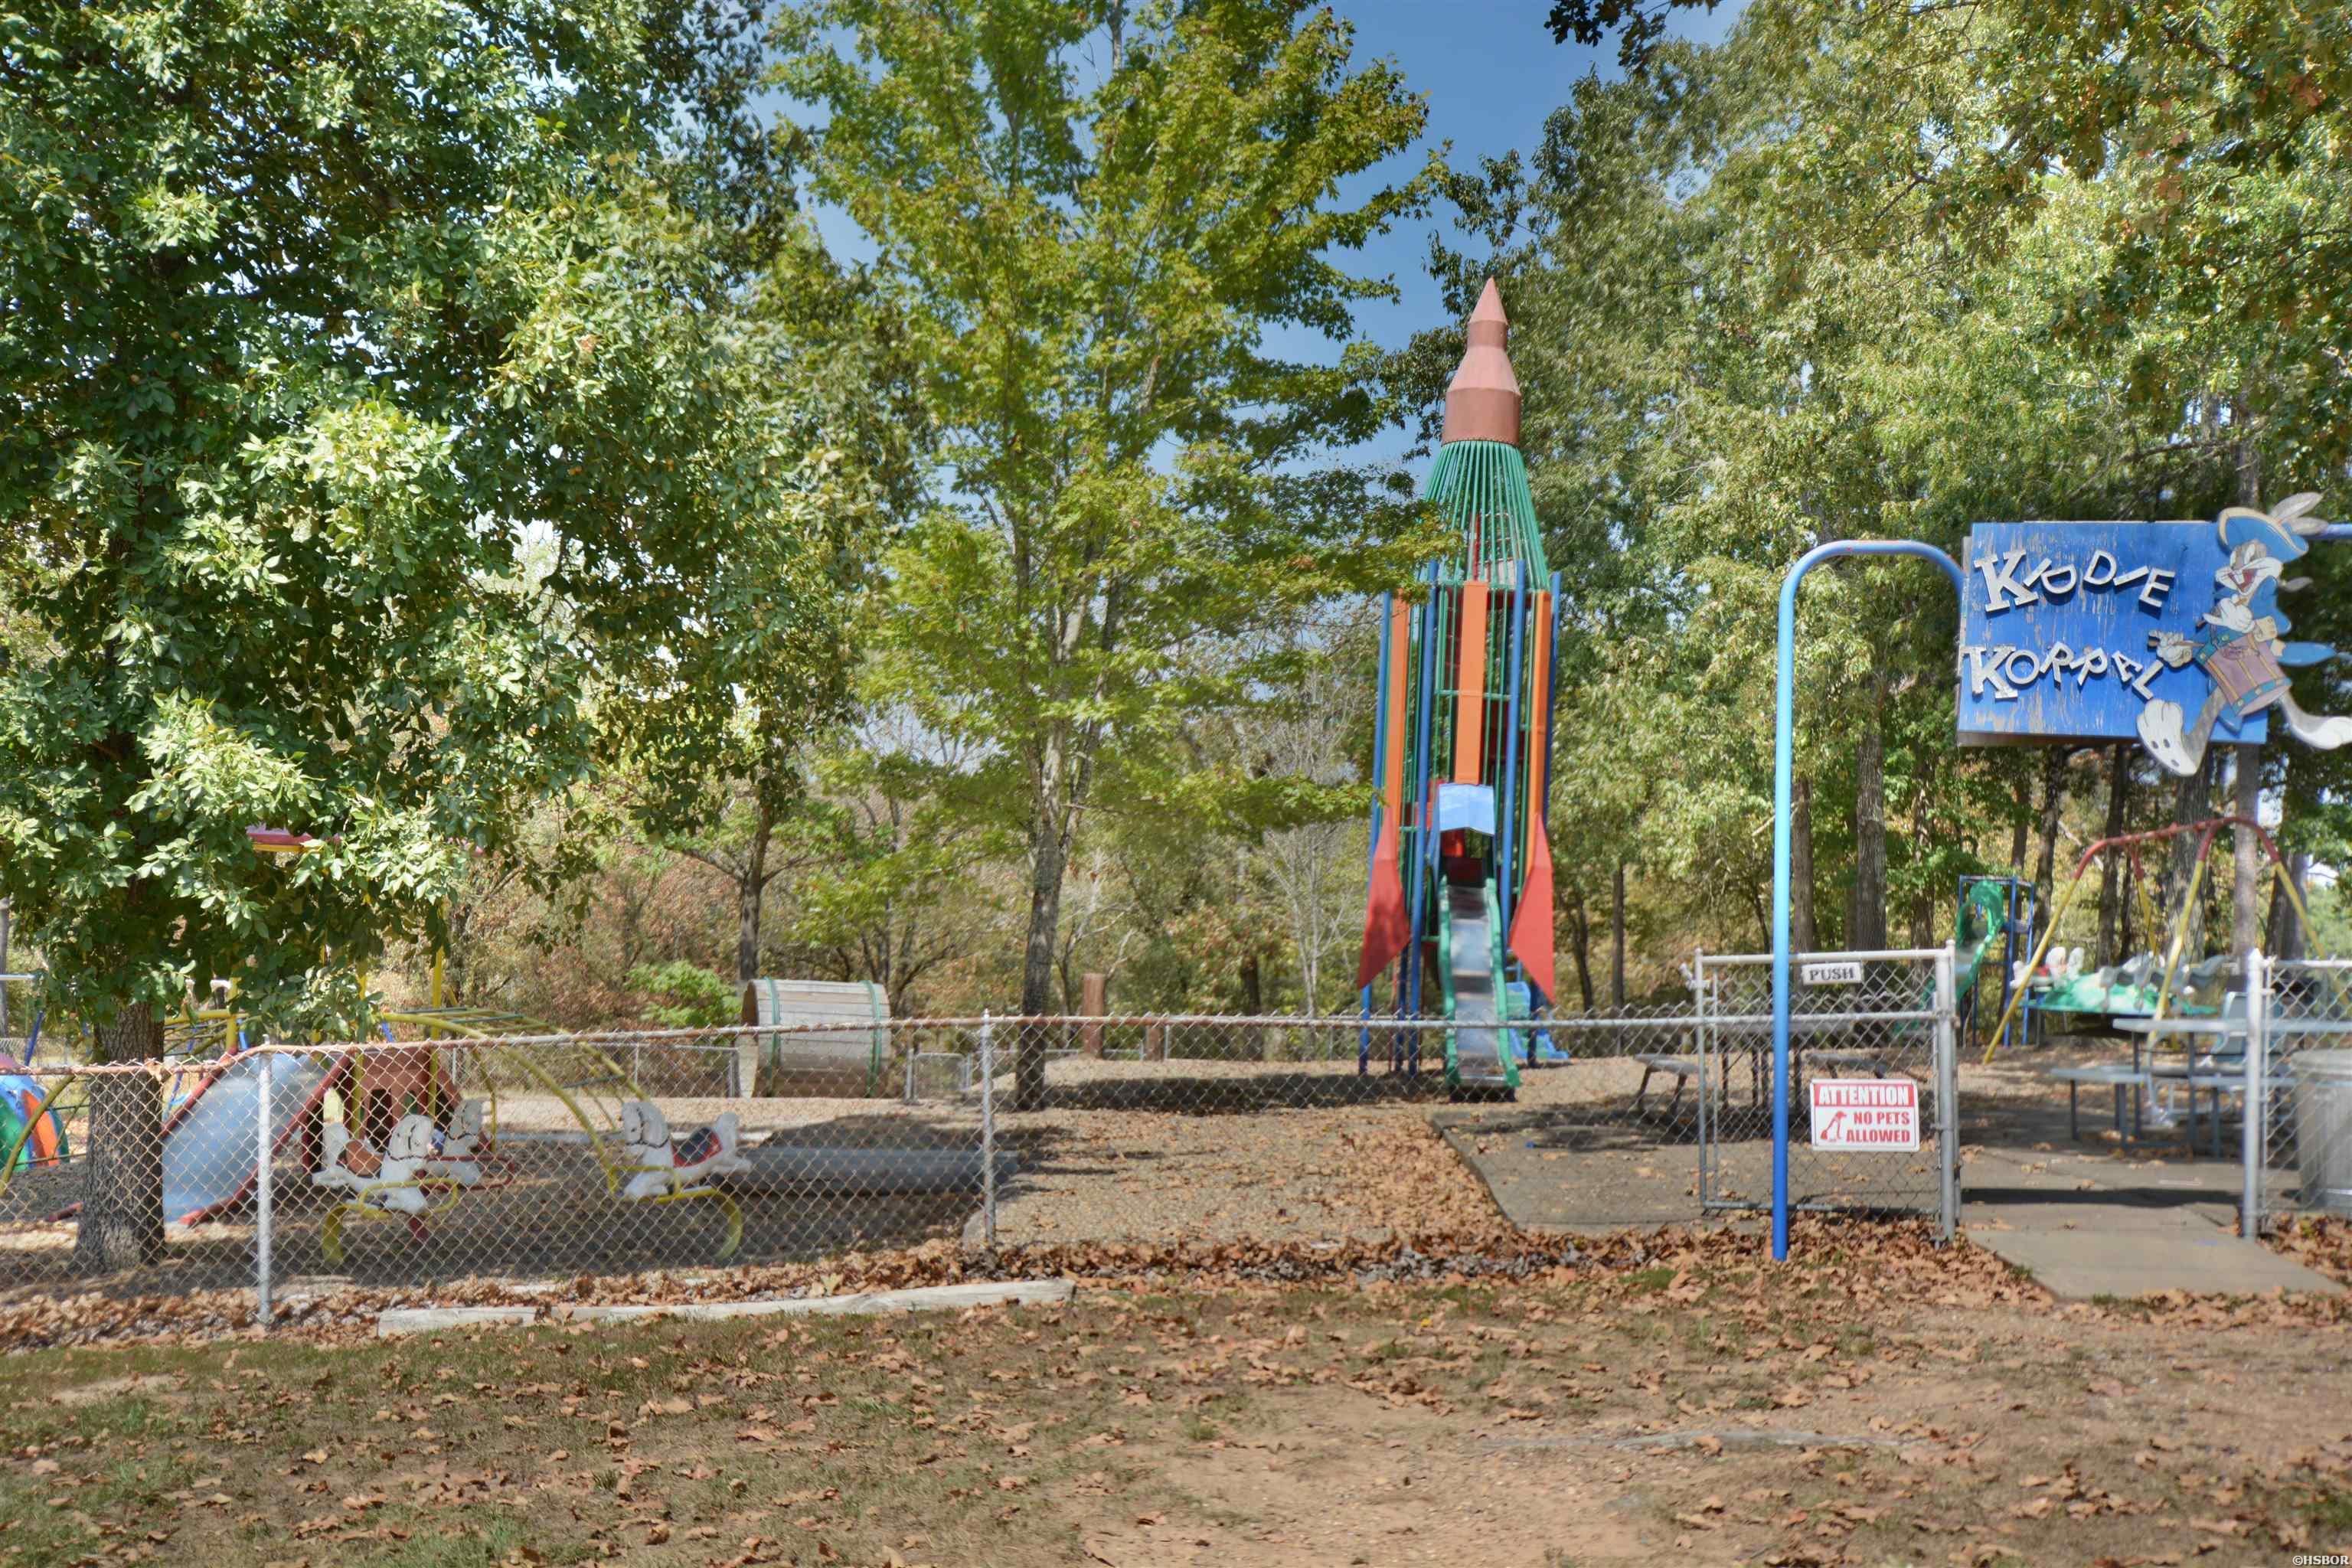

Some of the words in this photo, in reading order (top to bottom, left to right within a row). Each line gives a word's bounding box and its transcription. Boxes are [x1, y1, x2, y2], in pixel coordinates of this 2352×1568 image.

[1974, 549, 2175, 612] KIDDIE
[1962, 641, 2164, 700] KORRAL
[1808, 967, 1854, 982] PUSH
[1818, 1085, 1909, 1106] ATTENTION
[1854, 1112, 1873, 1125] NO
[1877, 1111, 1910, 1125] PETS
[1846, 1129, 1910, 1142] ALLOWED
